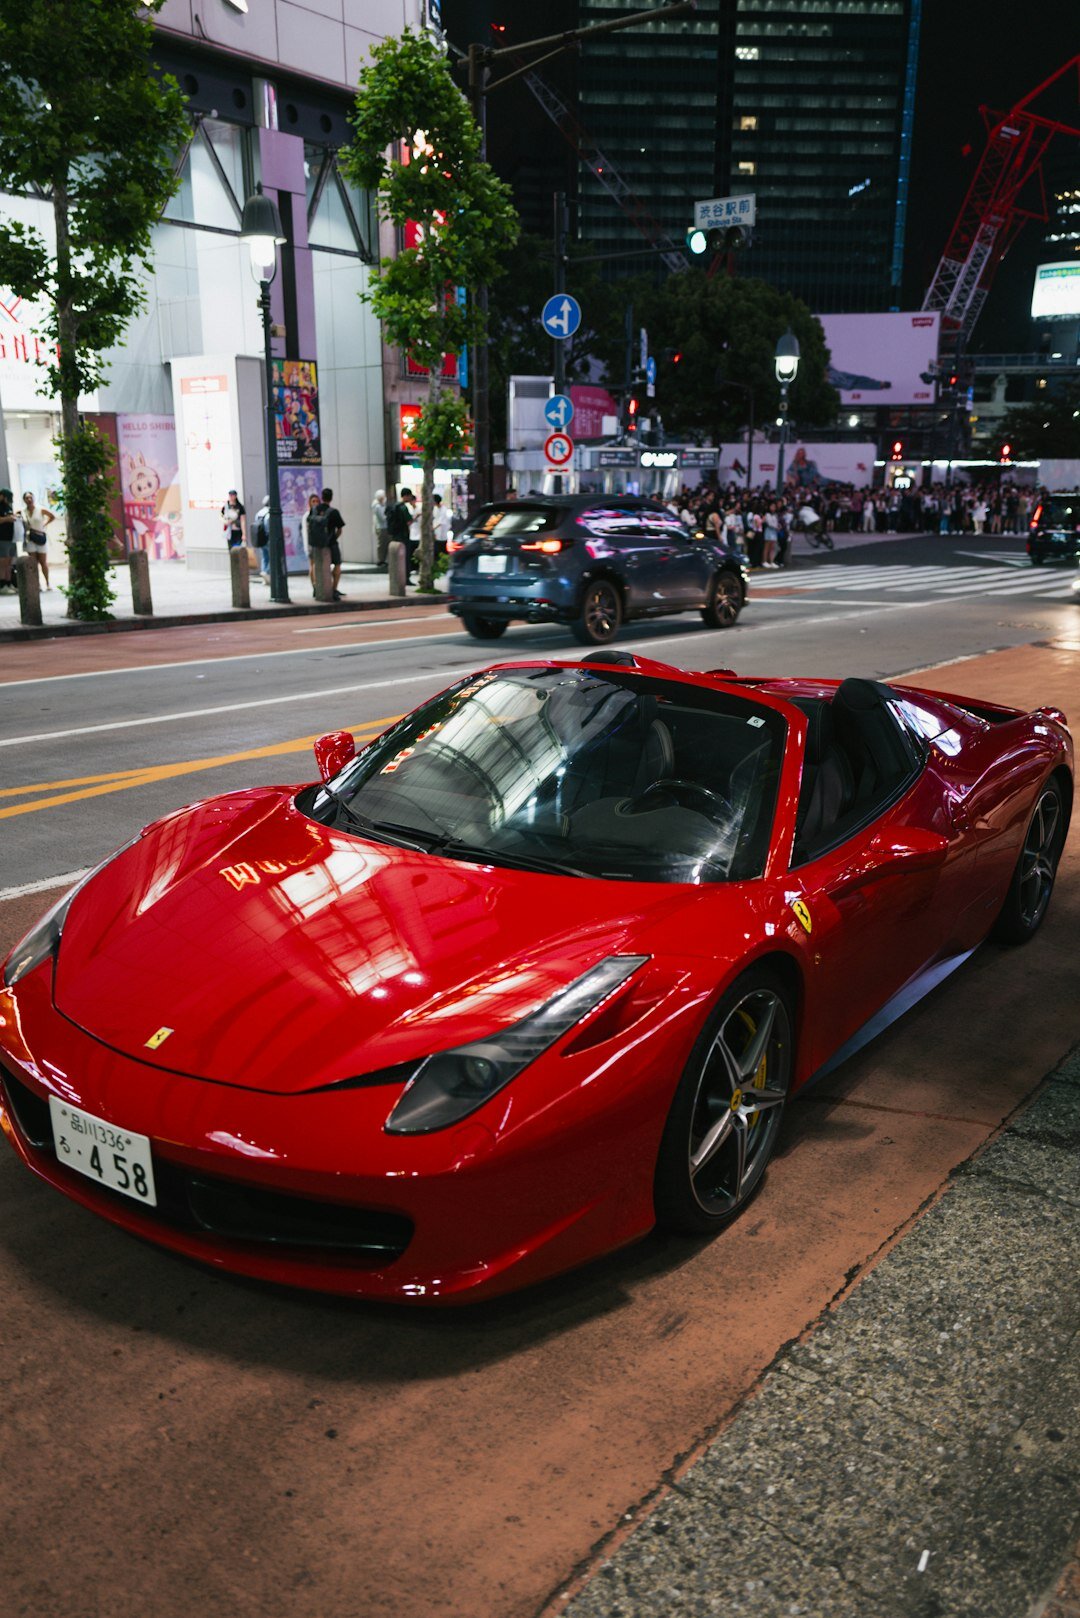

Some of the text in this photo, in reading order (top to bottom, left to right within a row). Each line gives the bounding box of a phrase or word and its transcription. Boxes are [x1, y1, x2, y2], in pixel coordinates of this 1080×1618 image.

[700, 199, 750, 219] 渋谷駅前
[707, 218, 730, 227] Shibuya
[122, 422, 148, 431] HELLO
